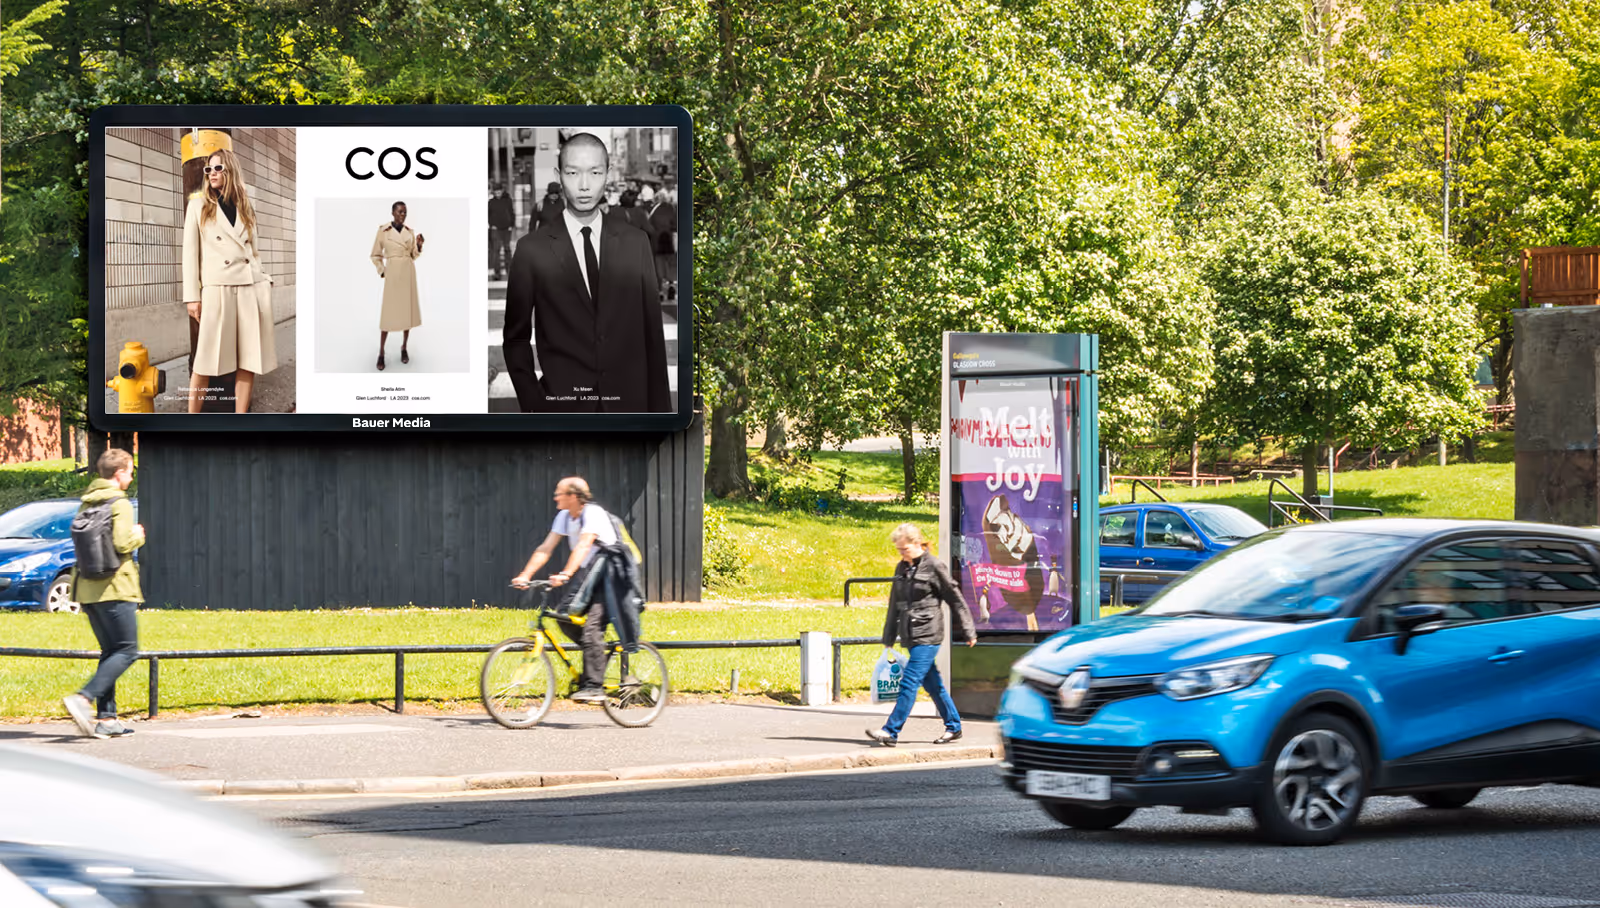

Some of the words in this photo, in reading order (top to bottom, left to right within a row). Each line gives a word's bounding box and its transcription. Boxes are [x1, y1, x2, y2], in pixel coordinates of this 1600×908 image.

[345, 146, 439, 181] COS
[952, 360, 978, 368] GLASGOW
[978, 359, 996, 367] CROSS
[352, 417, 390, 428] Bauer
[392, 417, 431, 428] Media
[980, 406, 1052, 439] Melt
[1008, 440, 1041, 458] with
[986, 457, 1045, 501] Joy
